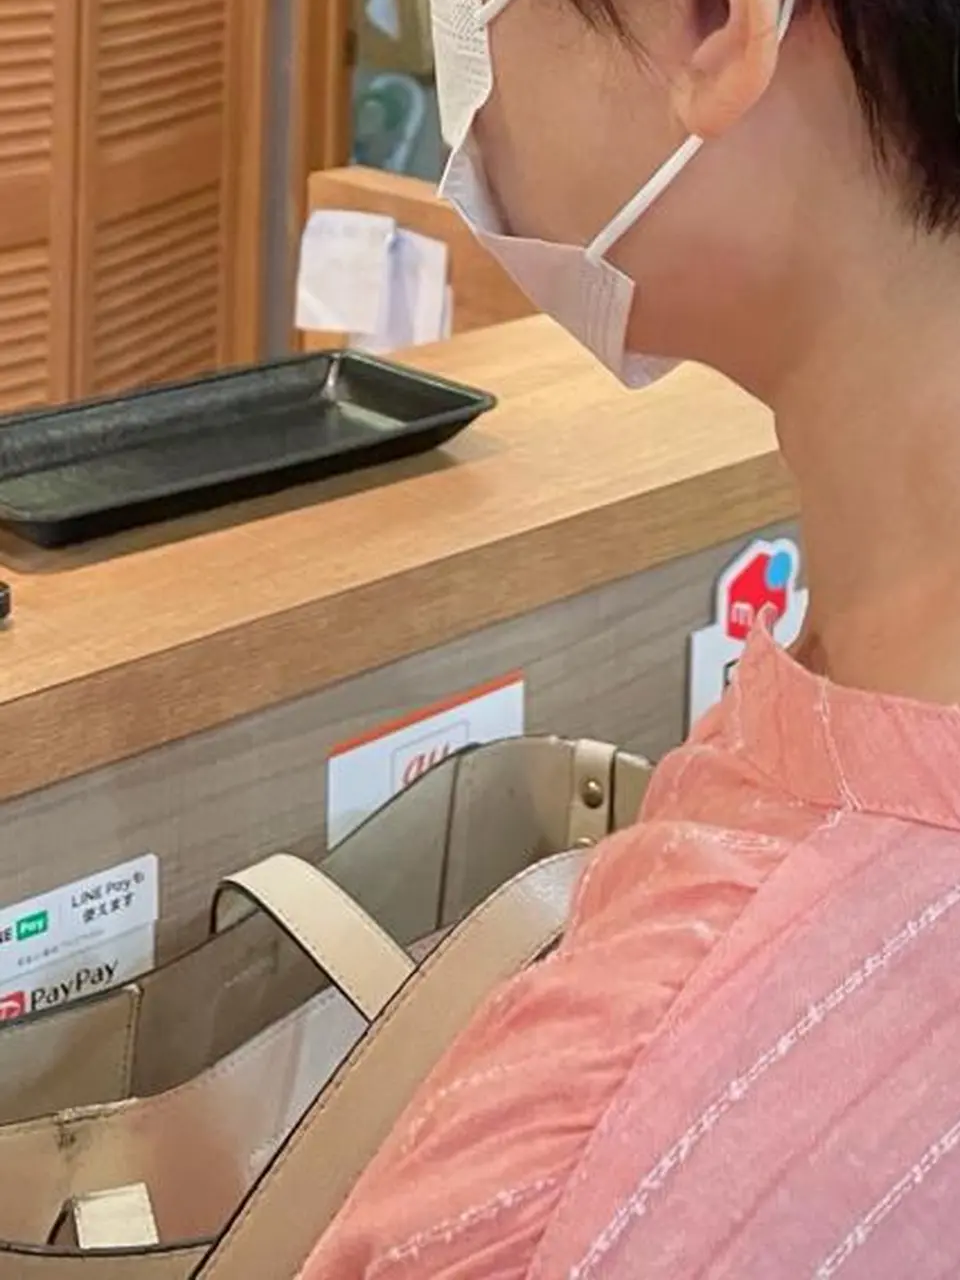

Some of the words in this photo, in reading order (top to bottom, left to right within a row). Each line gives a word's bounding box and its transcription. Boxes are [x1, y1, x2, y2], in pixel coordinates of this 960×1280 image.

[71, 885, 103, 909] LINE
[20, 919, 44, 937] Pay
[31, 959, 119, 1011] PayPay
